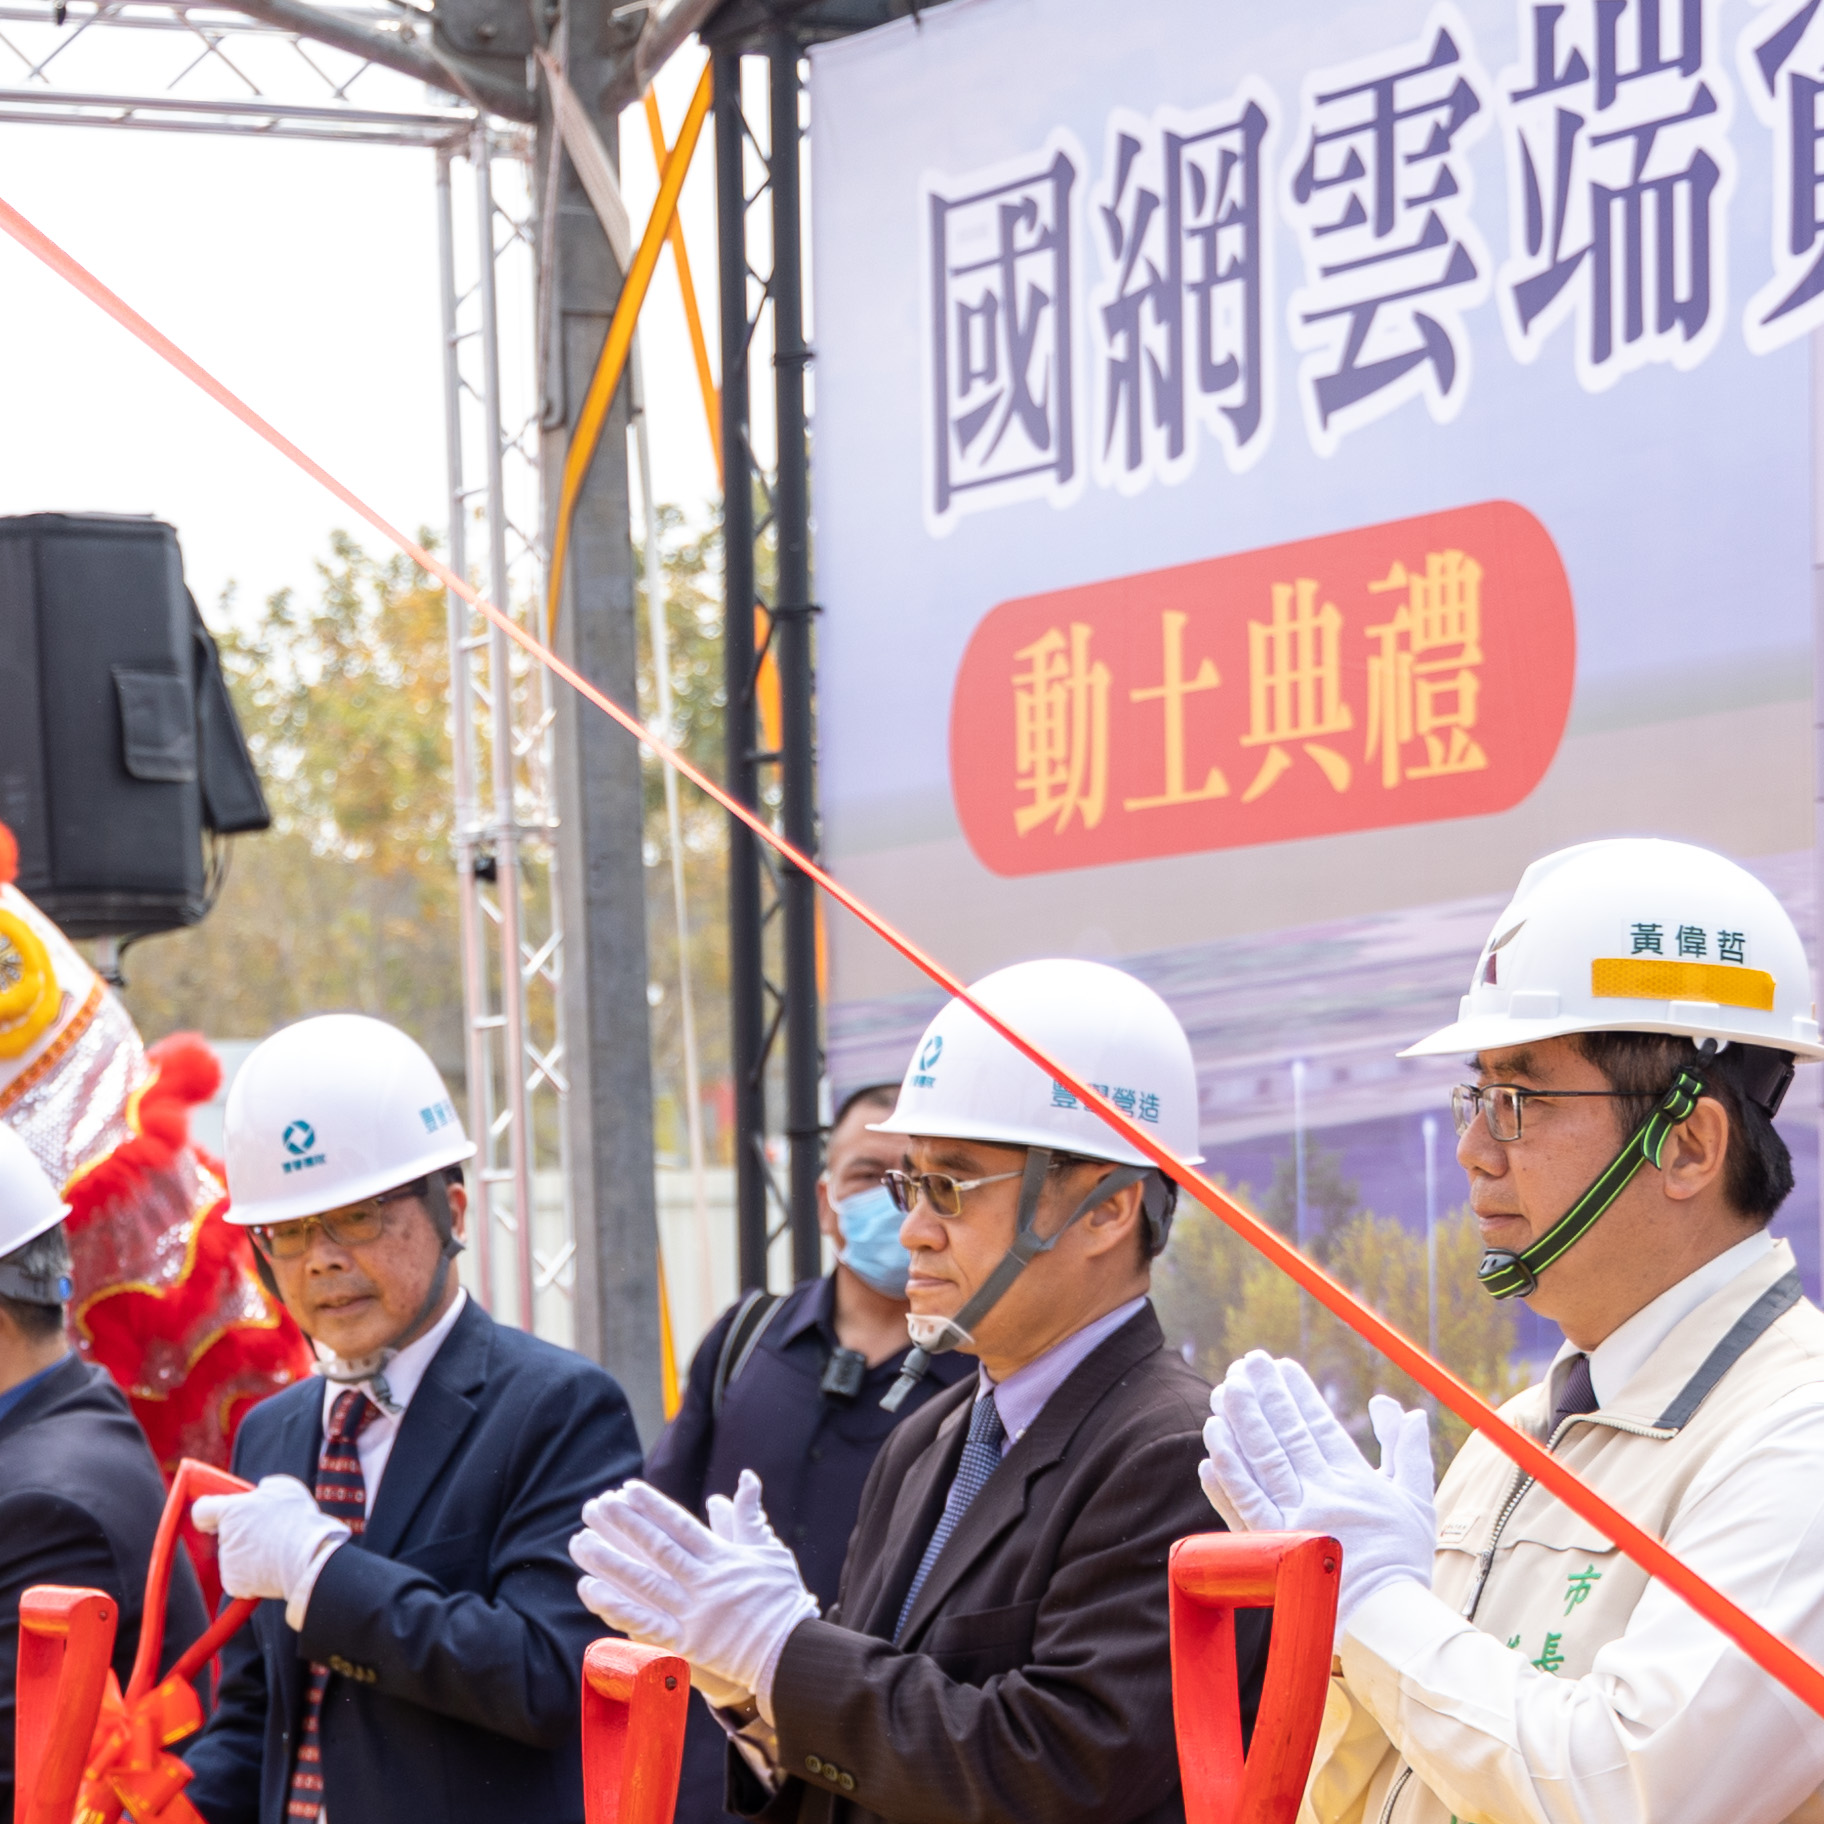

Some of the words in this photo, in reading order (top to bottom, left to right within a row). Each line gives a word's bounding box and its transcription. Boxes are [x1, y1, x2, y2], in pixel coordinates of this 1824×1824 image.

[1010, 548, 1488, 838] 動土典禮
[1630, 922, 1746, 965] 黃偉哲
